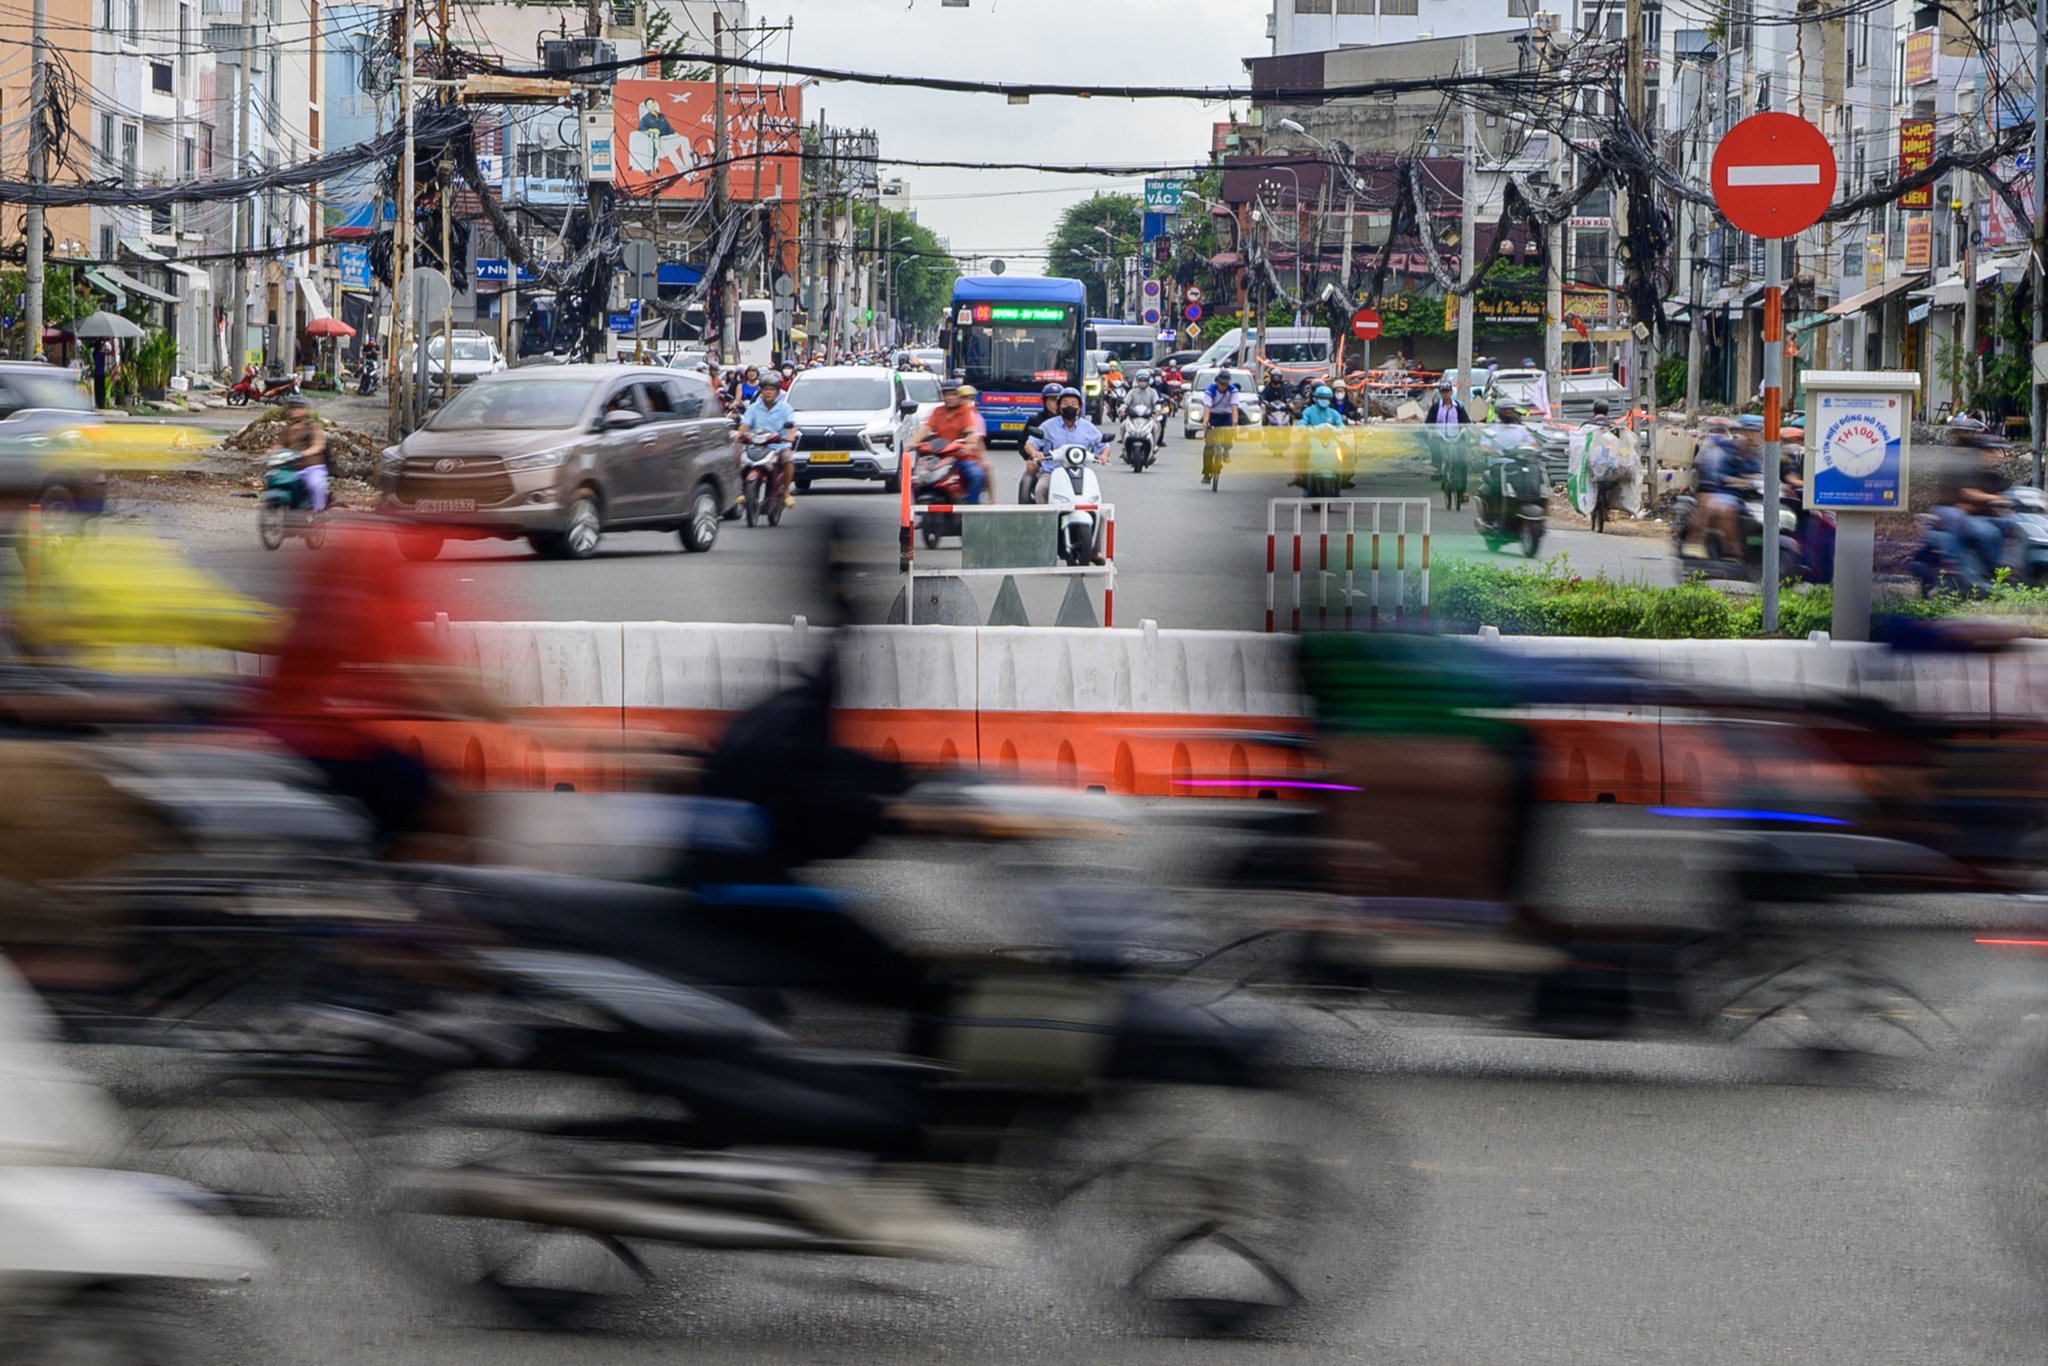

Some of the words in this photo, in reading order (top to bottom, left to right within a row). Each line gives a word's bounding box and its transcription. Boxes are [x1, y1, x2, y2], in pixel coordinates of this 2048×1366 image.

[488, 265, 523, 274] Nht
[960, 312, 970, 321] 08
[977, 306, 989, 319] 08
[1837, 426, 1879, 445] TH1004
